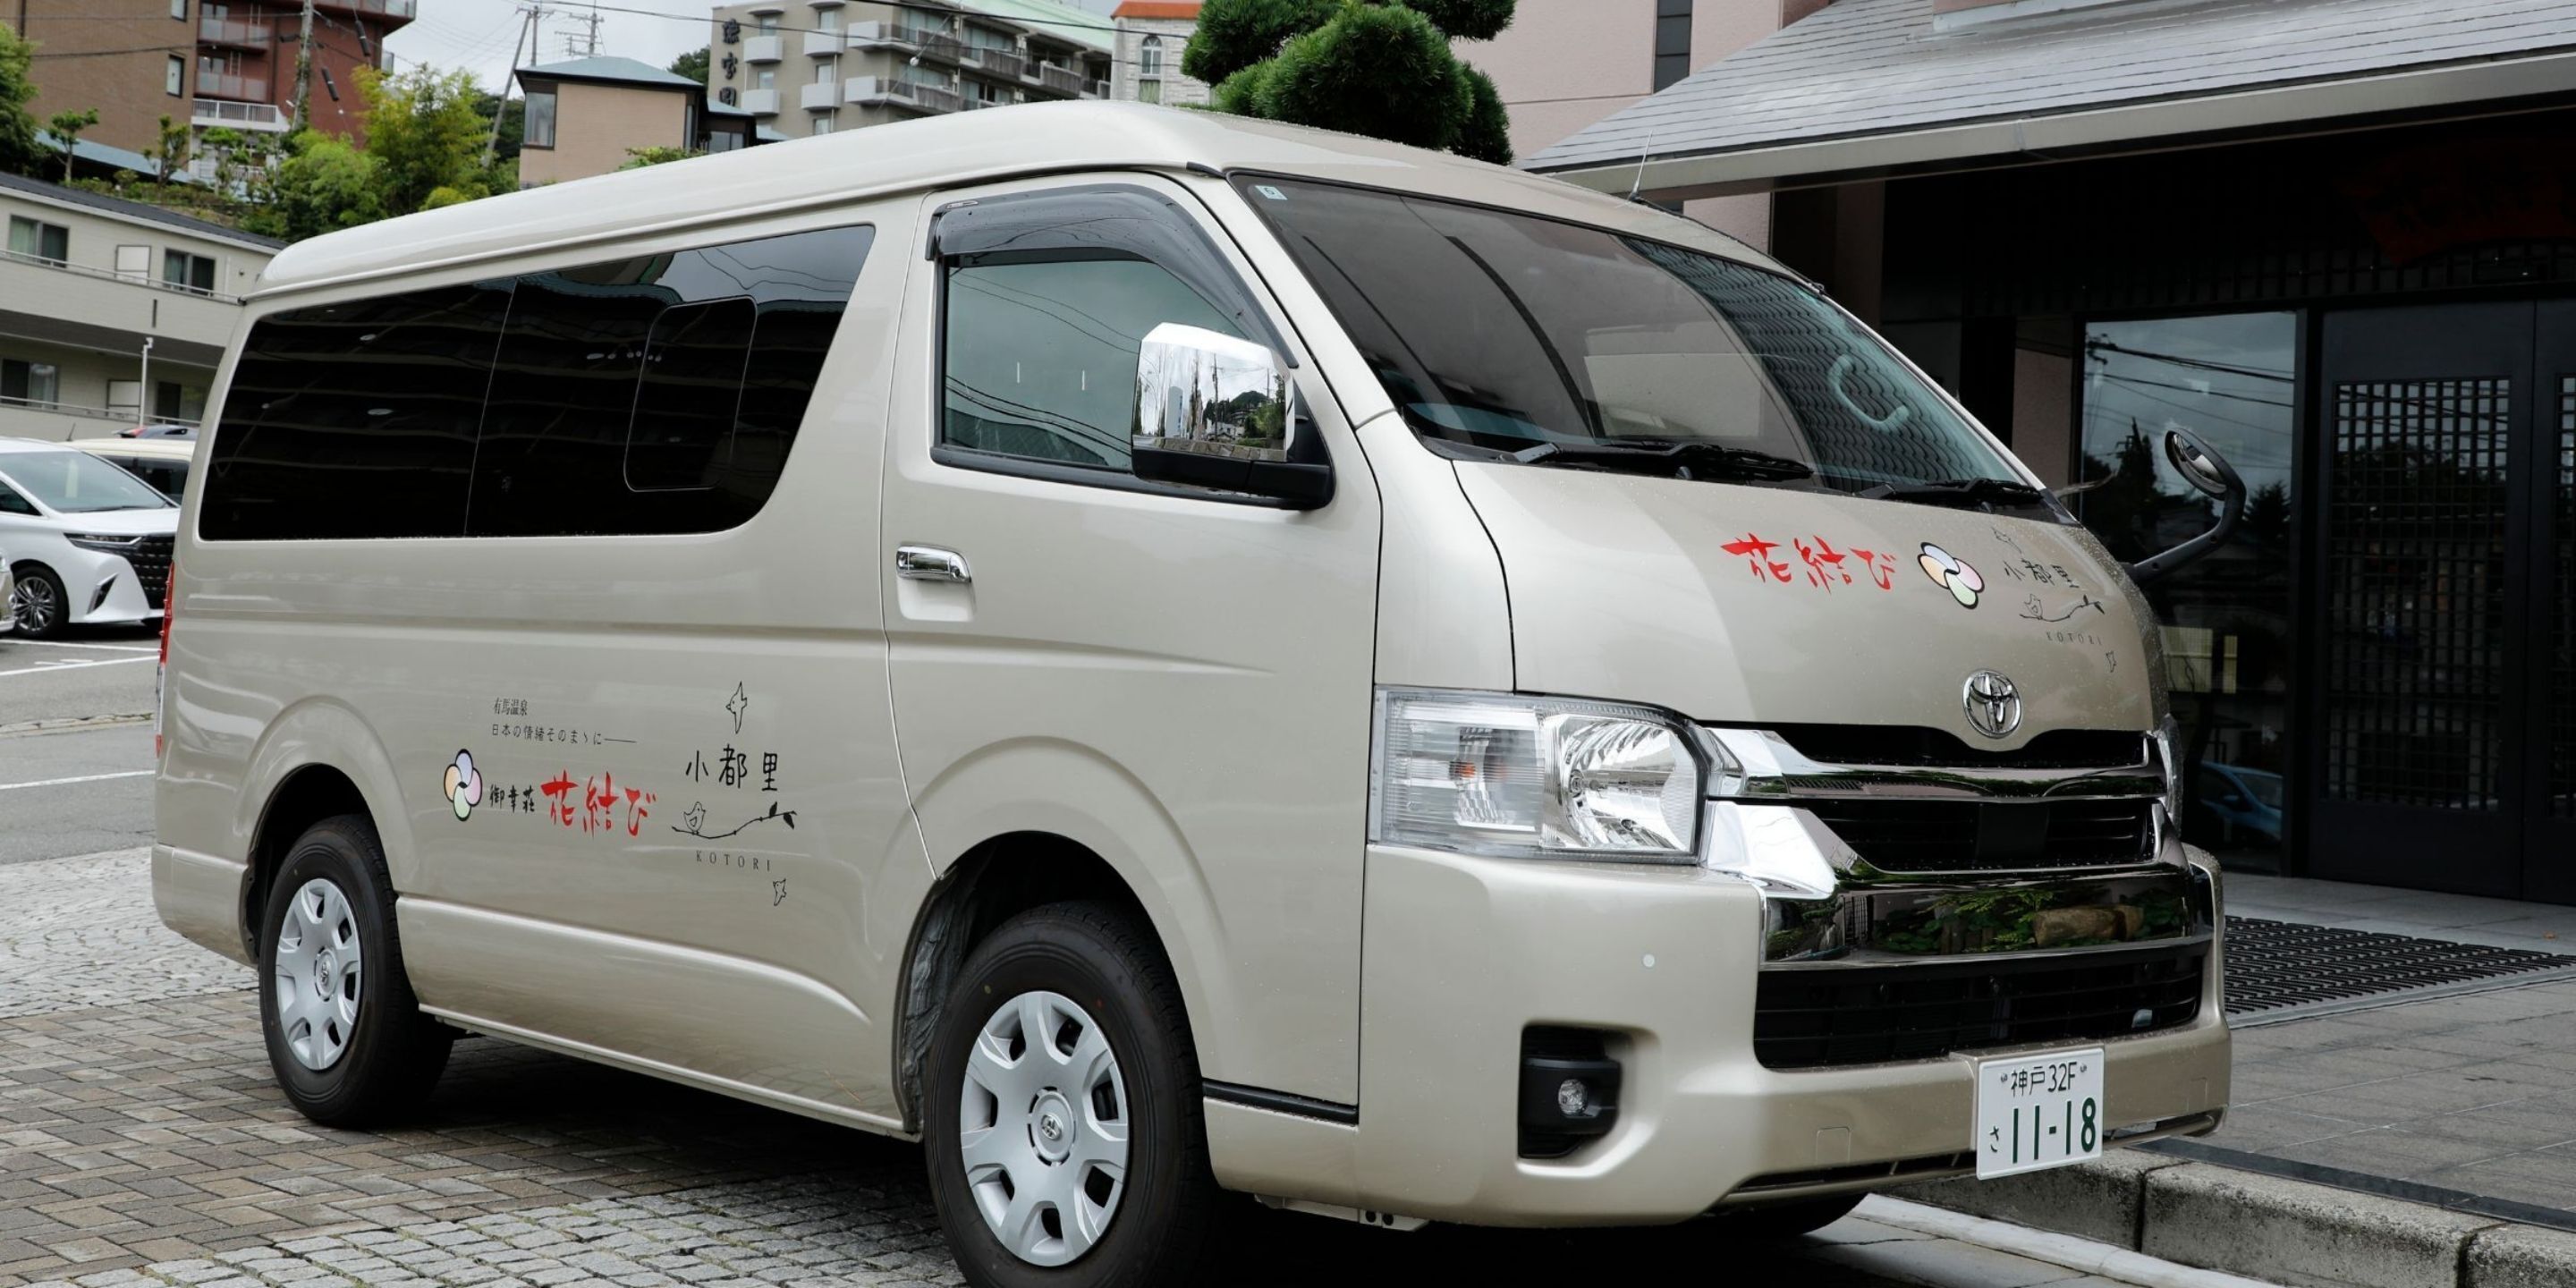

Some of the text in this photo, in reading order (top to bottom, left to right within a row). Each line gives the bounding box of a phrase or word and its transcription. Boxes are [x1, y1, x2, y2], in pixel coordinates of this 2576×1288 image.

[1721, 532, 1896, 594] 花結び
[2003, 558, 2080, 589] 小都里
[2046, 631, 2102, 645] KOTORI
[494, 697, 528, 716] 有馬温泉
[685, 743, 778, 792] 小都里
[490, 769, 657, 838] 御幸荘 花結び
[696, 850, 771, 872] KOTORI
[1989, 1097, 2097, 1164] さ 11-18
